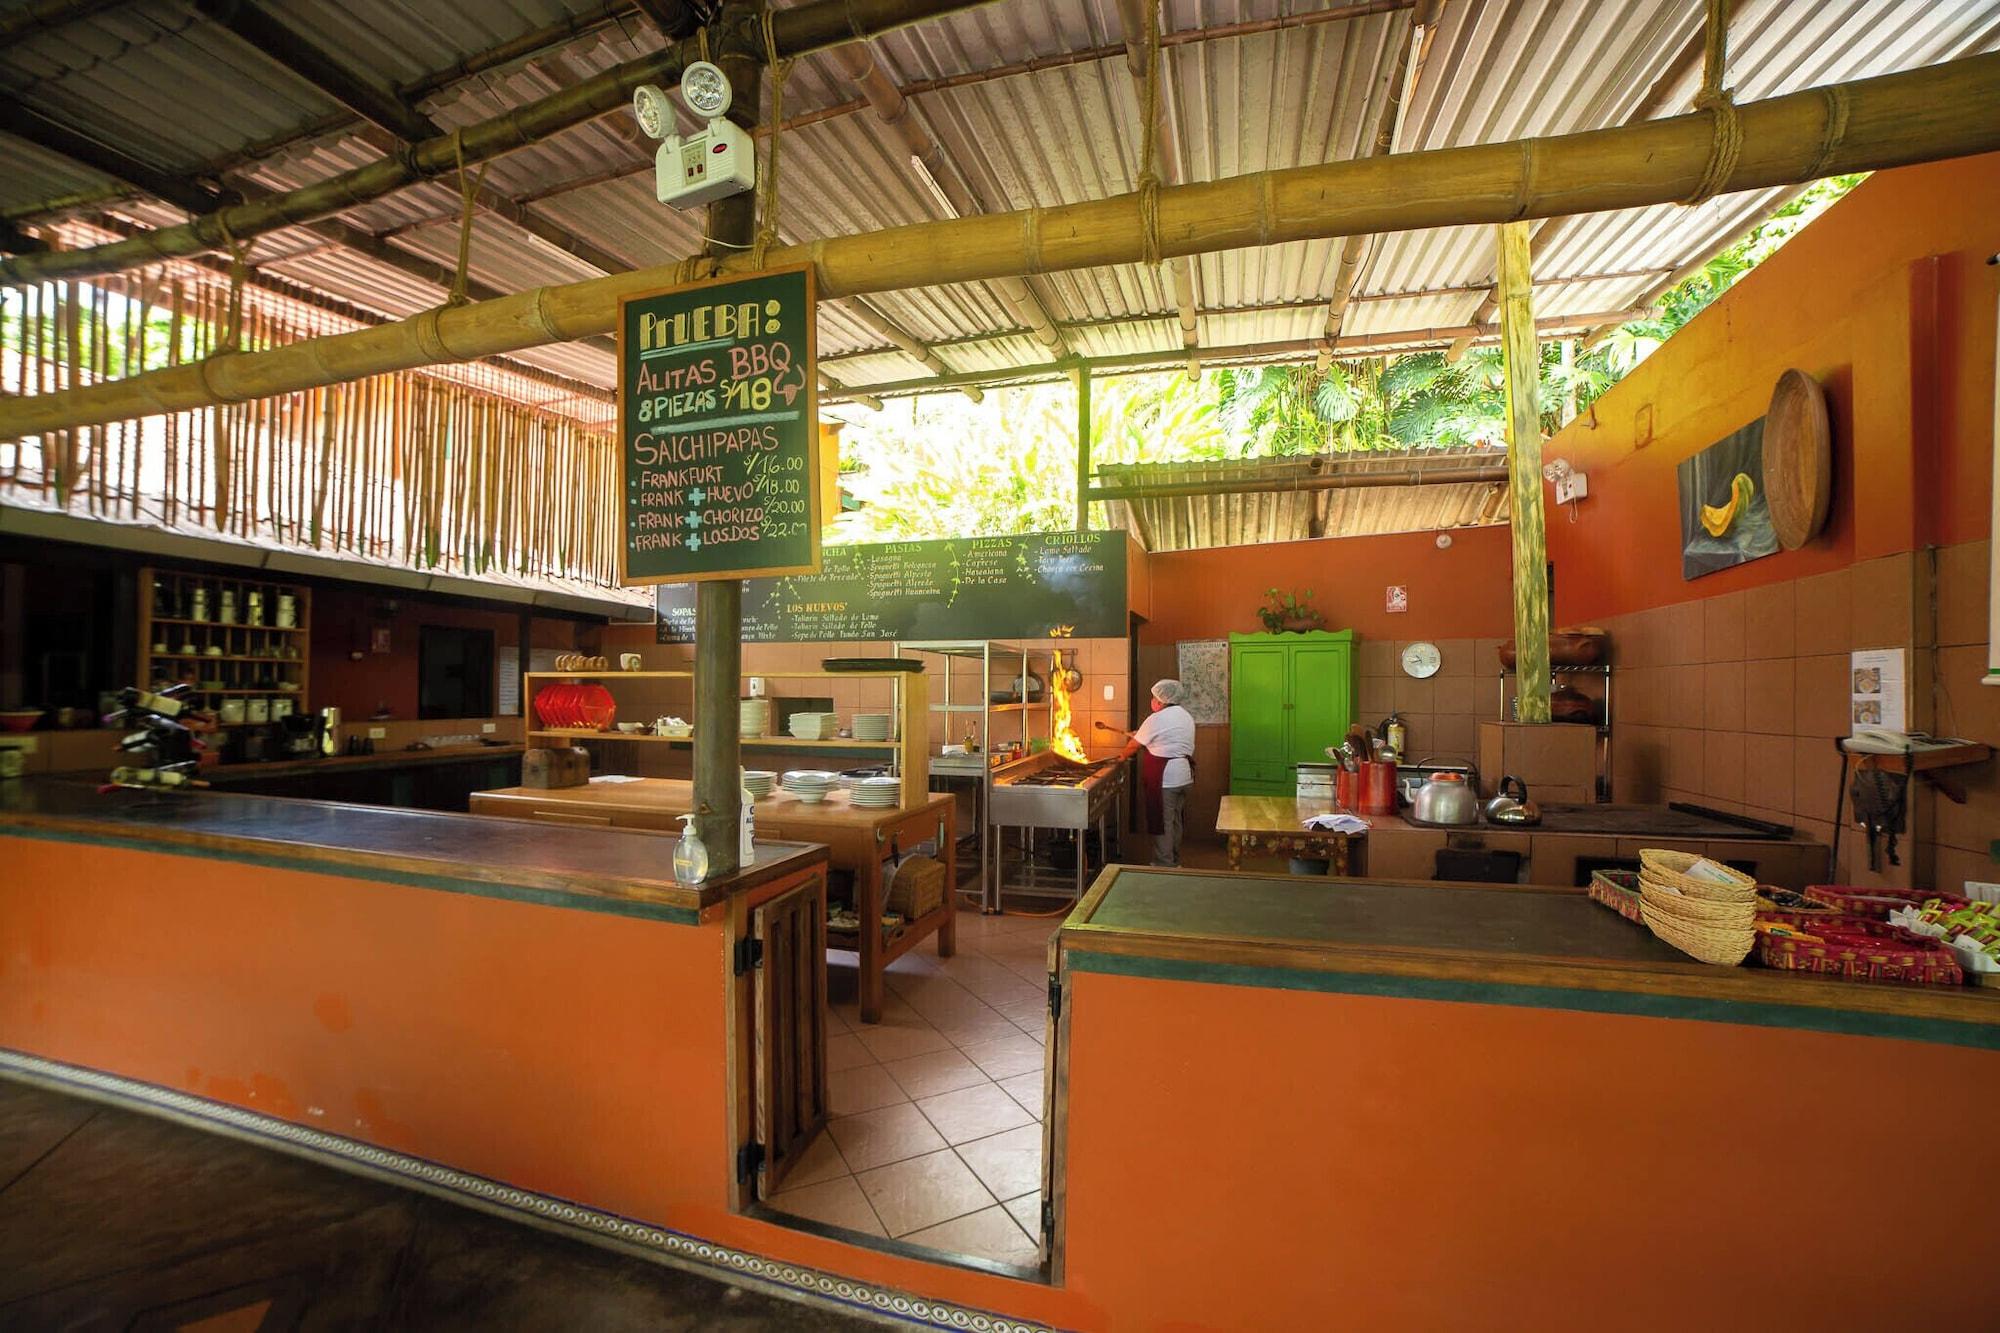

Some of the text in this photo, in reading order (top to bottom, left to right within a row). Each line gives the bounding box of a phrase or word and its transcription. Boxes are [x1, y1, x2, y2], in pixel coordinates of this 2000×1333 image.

[637, 342, 791, 395] ALITAS BBQ
[654, 389, 717, 419] PIEZAS
[634, 425, 779, 466] SALCHIPAPAS
[641, 464, 724, 490] FRANKFURT
[641, 489, 684, 507] FRANK
[708, 482, 754, 503] HUEVO
[638, 511, 684, 531] FRANK
[703, 507, 764, 525] CHORIZO
[636, 532, 682, 552] FRANK
[885, 543, 922, 553] PASTAS
[972, 537, 1013, 549] PIZZAS
[1045, 533, 1101, 545] CRIOLLOS
[967, 549, 1008, 558] Americana
[965, 576, 1007, 584] De la Casa
[787, 603, 803, 613] LOS
